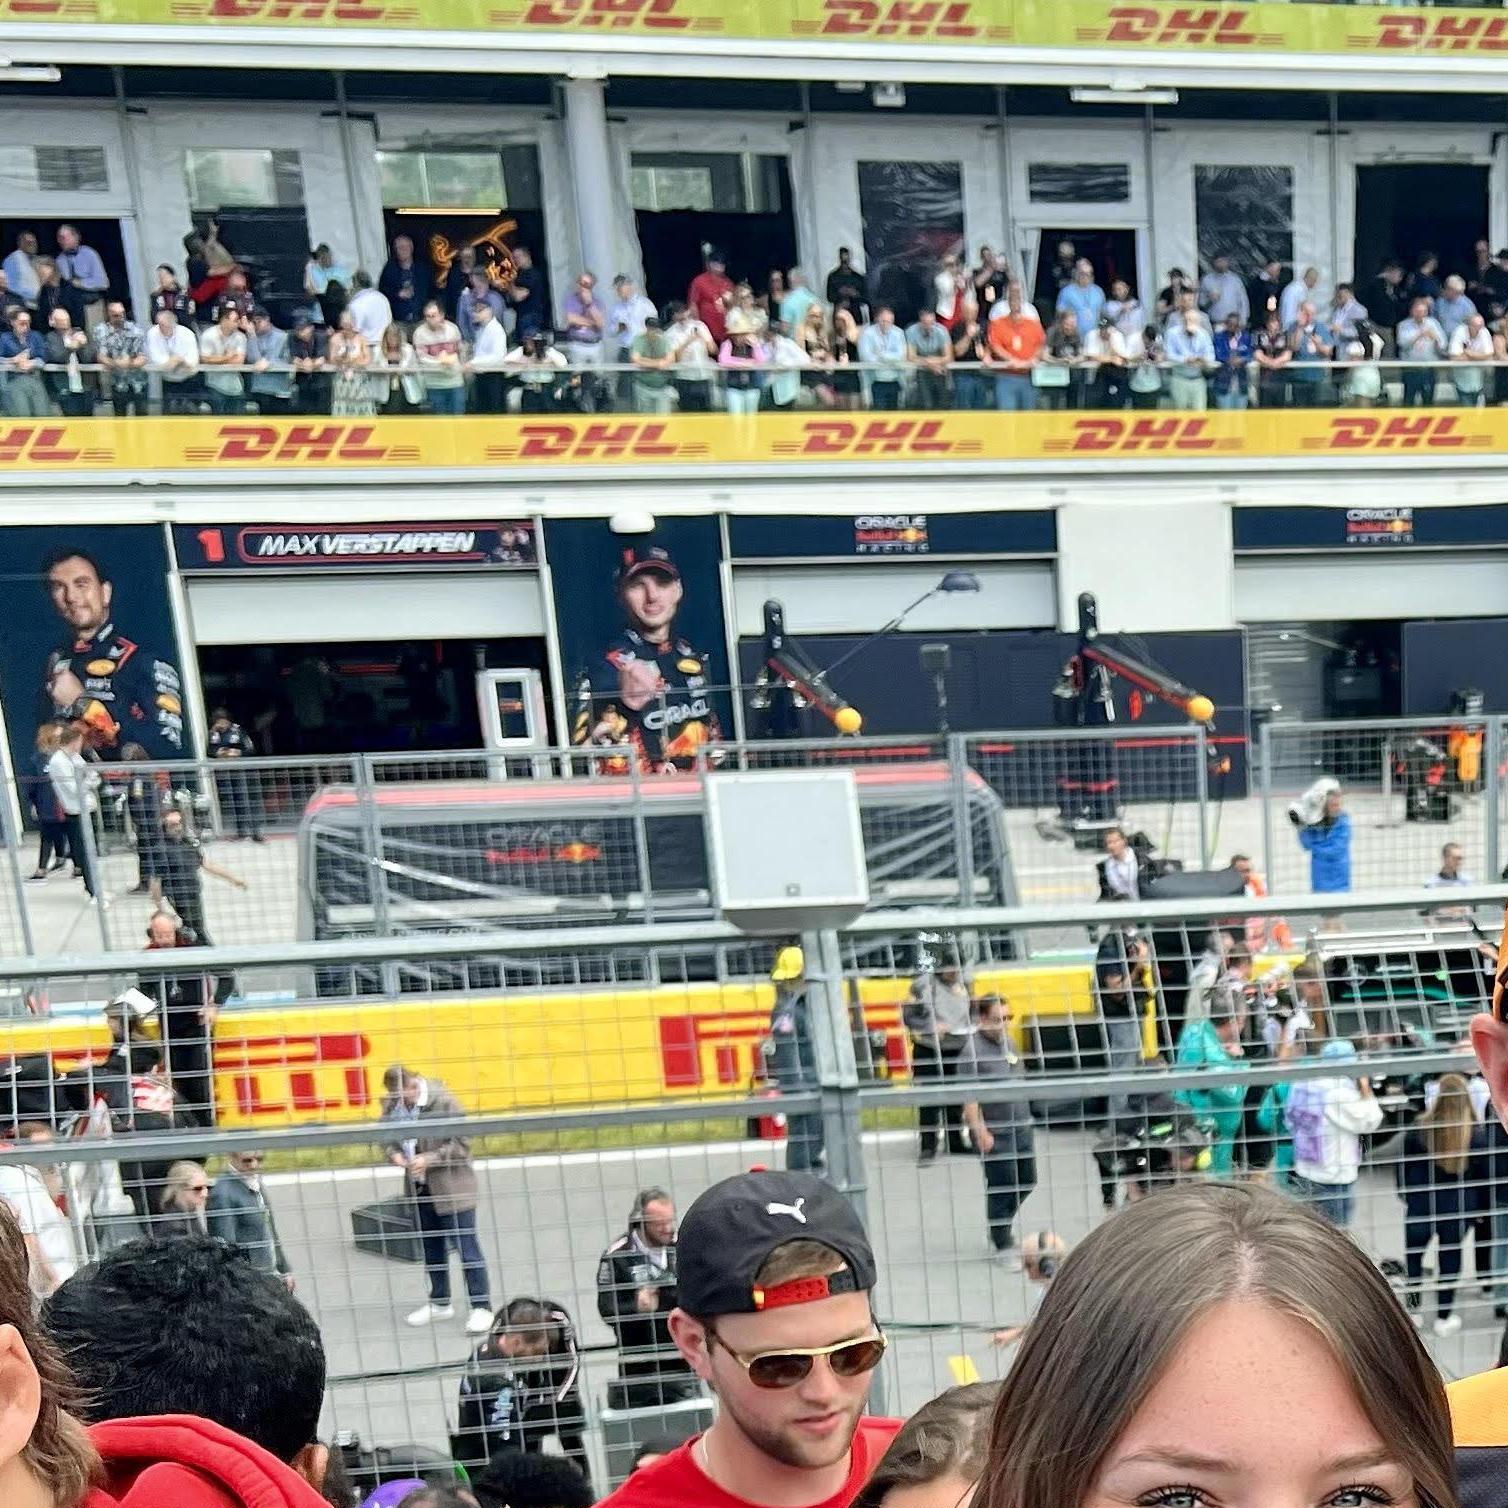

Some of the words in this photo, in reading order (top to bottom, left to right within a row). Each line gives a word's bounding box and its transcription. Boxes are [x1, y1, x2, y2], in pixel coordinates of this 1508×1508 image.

[821, 0, 979, 37] DHL
[1106, 7, 1258, 45] DHL
[217, 426, 394, 461] DHL
[518, 424, 683, 457] DHL
[801, 420, 956, 453] DHL
[1072, 418, 1215, 450] DHL
[1328, 416, 1466, 448] DHL
[197, 529, 226, 562] 1
[257, 535, 319, 556] MAX
[319, 531, 475, 555] VERSTAPPEN
